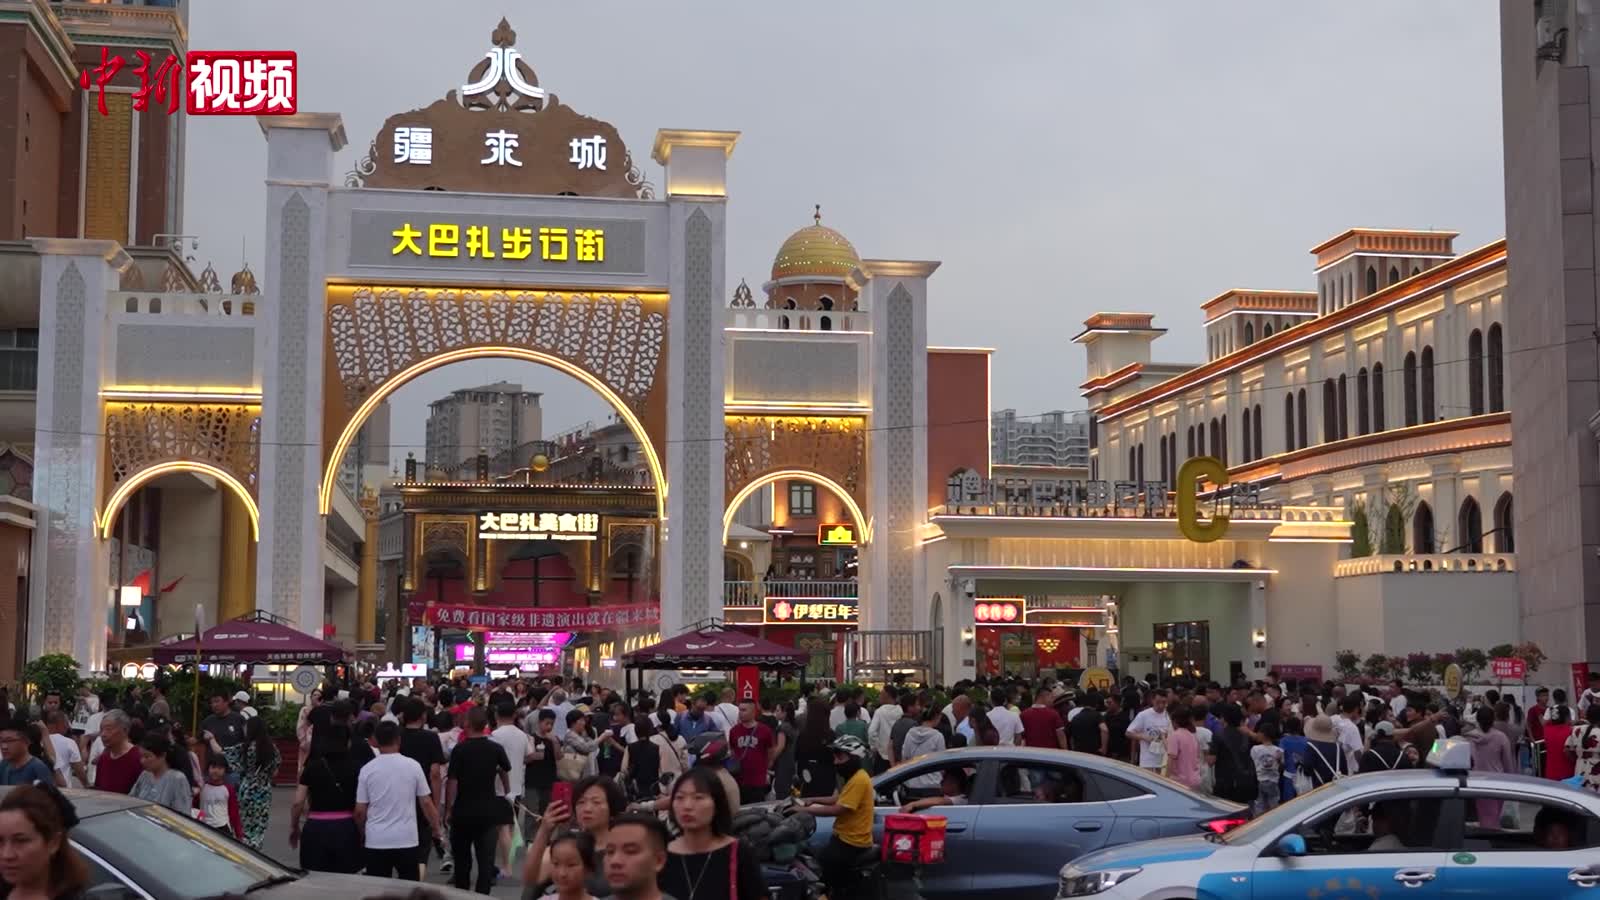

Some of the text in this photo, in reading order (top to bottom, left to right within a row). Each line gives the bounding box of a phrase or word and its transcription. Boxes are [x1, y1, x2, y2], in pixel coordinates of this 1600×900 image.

[391, 222, 606, 264] 大巴扎步行街
[479, 512, 599, 532] 大巴扎美食街
[743, 679, 753, 700] 入口
